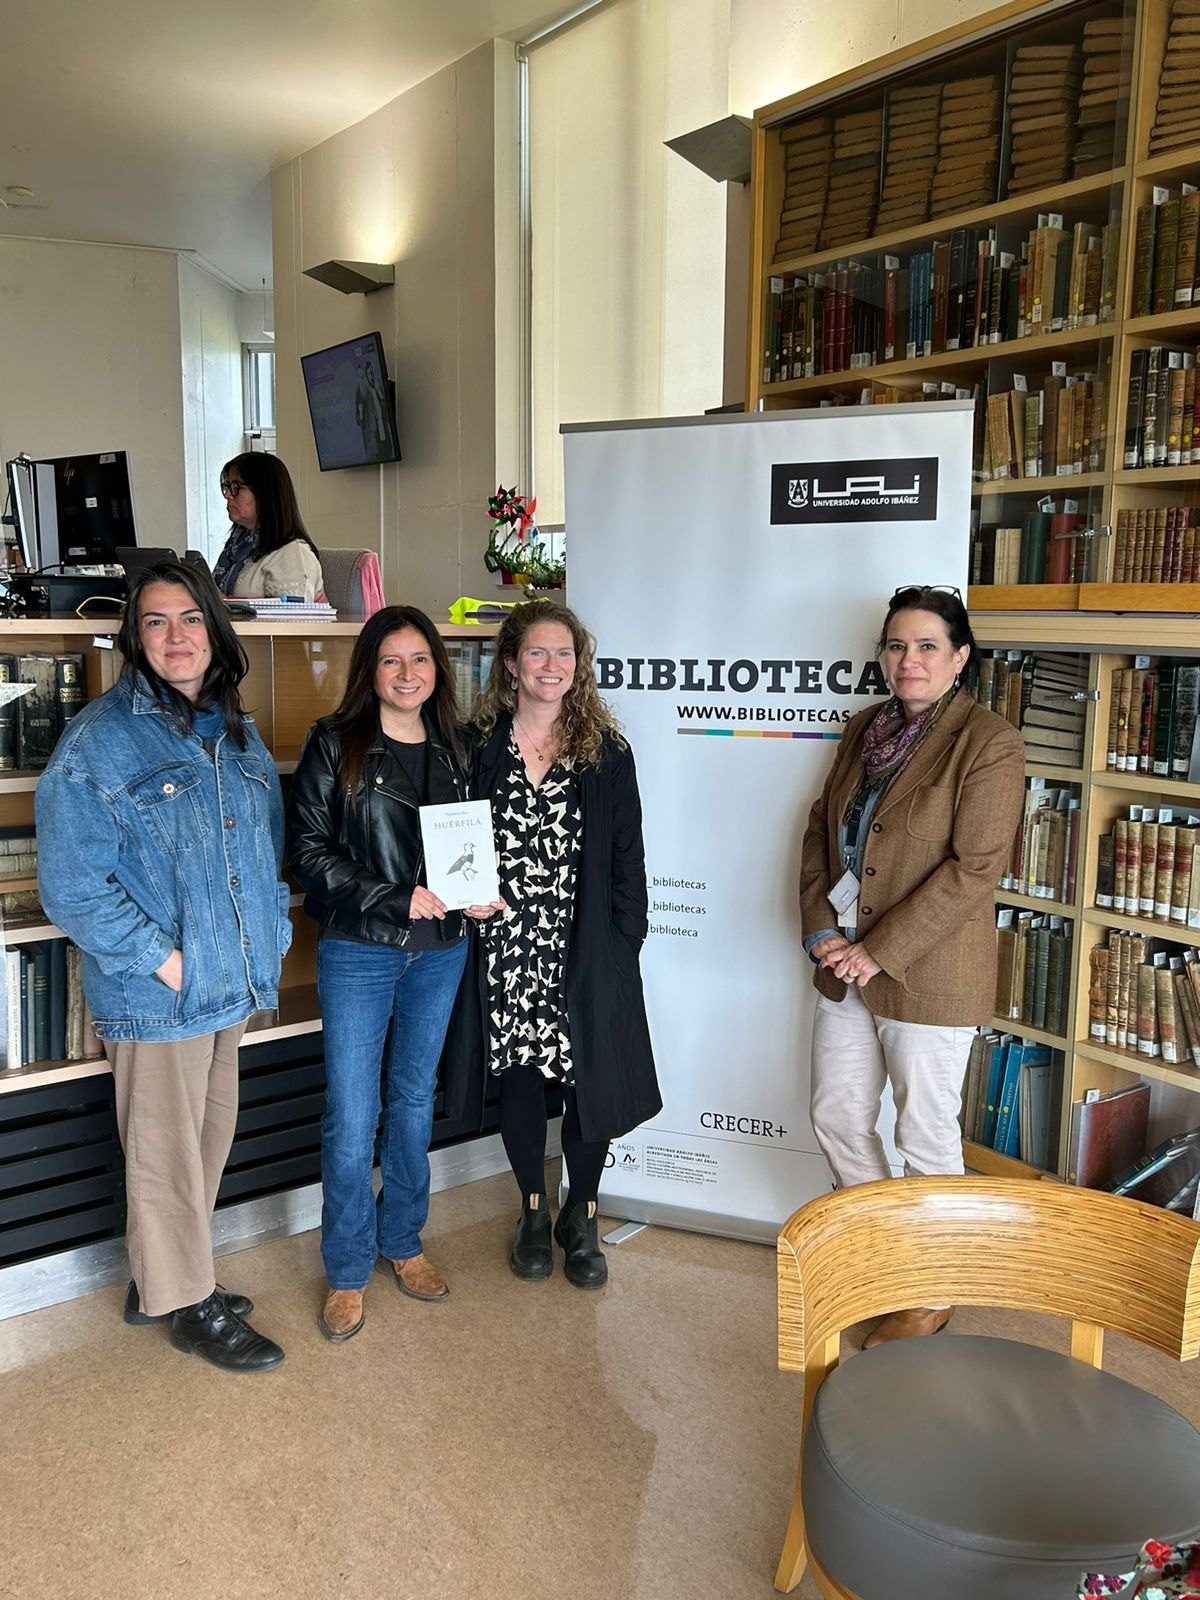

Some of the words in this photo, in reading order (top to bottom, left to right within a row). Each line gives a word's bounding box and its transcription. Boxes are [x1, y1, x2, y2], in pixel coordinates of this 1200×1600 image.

[812, 499, 860, 508] UNIVERSIDAD
[860, 498, 890, 506] ADOLFO
[891, 495, 919, 505] IBÁÑEZ
[676, 705, 862, 723] WWW.BIBLIOTECAS
[647, 924, 698, 937] biblioteca
[700, 1112, 788, 1138] CRECER+
[617, 1143, 636, 1152] AÑOS
